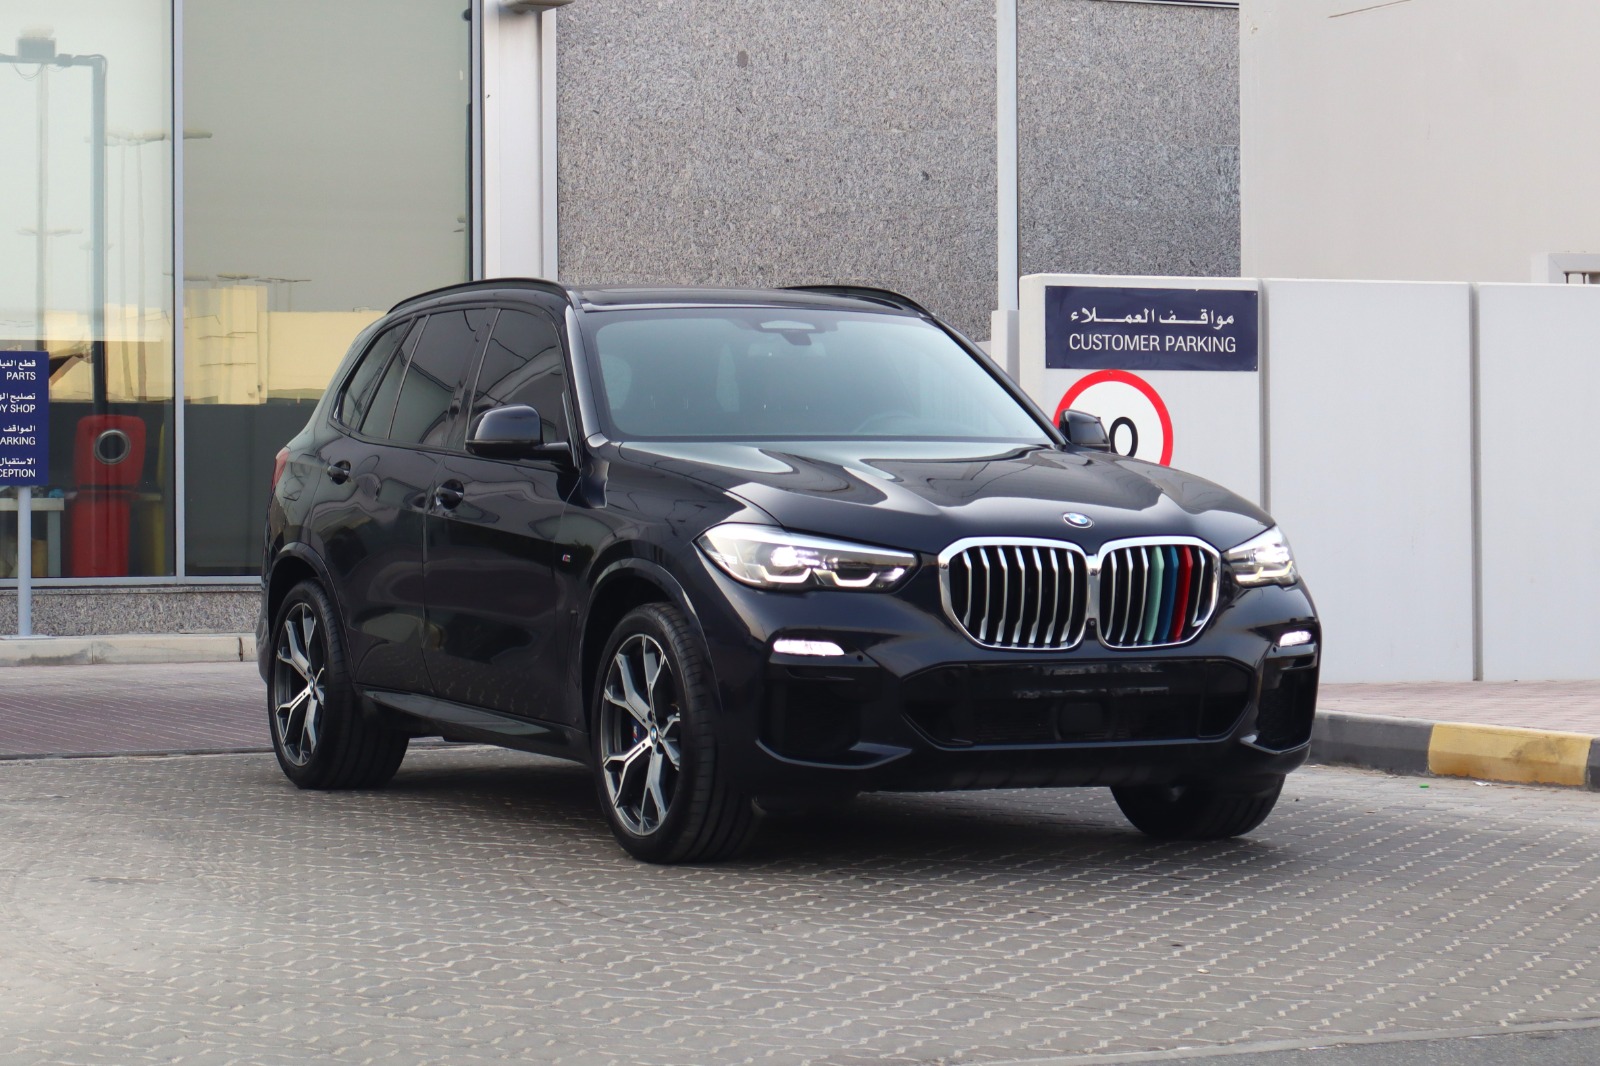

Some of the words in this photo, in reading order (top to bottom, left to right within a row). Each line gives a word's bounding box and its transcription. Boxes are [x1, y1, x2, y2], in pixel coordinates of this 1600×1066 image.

[1070, 306, 1155, 324] العملاء
[1159, 307, 1235, 330] مواقف
[1069, 333, 1161, 352] CUSTOMER
[1165, 335, 1236, 353] PARKING
[18, 359, 36, 371] قطع
[6, 371, 36, 381] PARTS
[10, 404, 36, 413] SHOP
[3, 424, 36, 434] المواقف
[0, 437, 36, 446] ARKING
[1108, 416, 1139, 458] 0
[0, 469, 36, 478] EPTION
